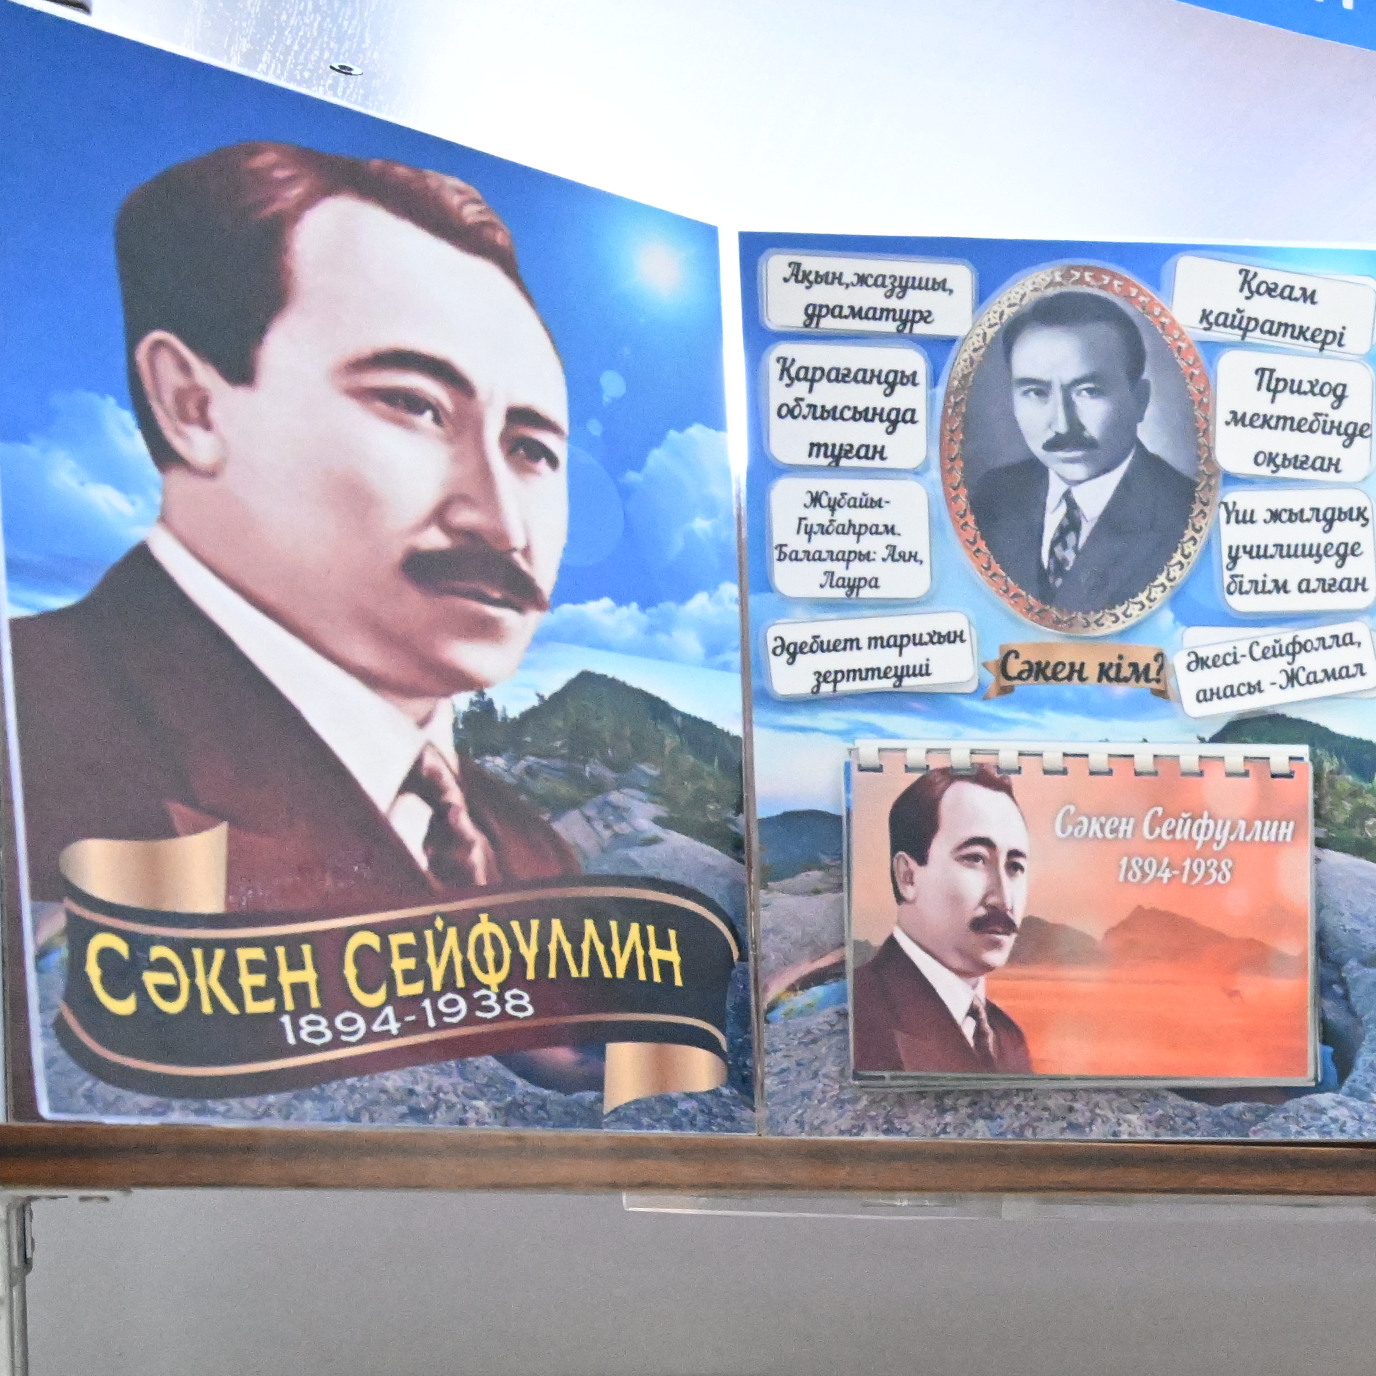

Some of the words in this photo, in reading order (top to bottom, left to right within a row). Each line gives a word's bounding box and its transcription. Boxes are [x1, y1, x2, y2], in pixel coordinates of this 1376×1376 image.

[1238, 268, 1317, 305] Қоғам
[803, 298, 933, 328] драматург
[1199, 307, 1345, 351] қайраткері
[777, 356, 918, 391] Қарағанды
[1255, 365, 1348, 409] Приход
[777, 398, 917, 434] облысында
[1224, 409, 1371, 440] мектебінде
[809, 439, 886, 466] туған
[1254, 449, 1342, 474] оқыған
[1265, 502, 1368, 526] жылдық
[775, 543, 877, 568] Балалары:
[885, 543, 923, 567] Аян,
[1226, 538, 1362, 571] училищеде
[820, 571, 879, 598] Лаура
[1226, 574, 1290, 598] білім
[1297, 569, 1368, 596] алған
[772, 634, 861, 663] Әдебиет
[868, 626, 966, 655] тарихын
[813, 658, 930, 693] зерттеуші
[1001, 648, 1087, 684] Сәкен
[1098, 650, 1166, 685] кім?
[1054, 804, 1136, 842] Сәкен
[1142, 804, 1295, 852] Сейфуллин
[1118, 857, 1233, 886] 1894-1938
[85, 930, 320, 1016] СӘКЕН
[342, 913, 684, 1010] СЕЙФУЛЛИН
[279, 987, 535, 1047] 1894-1938
